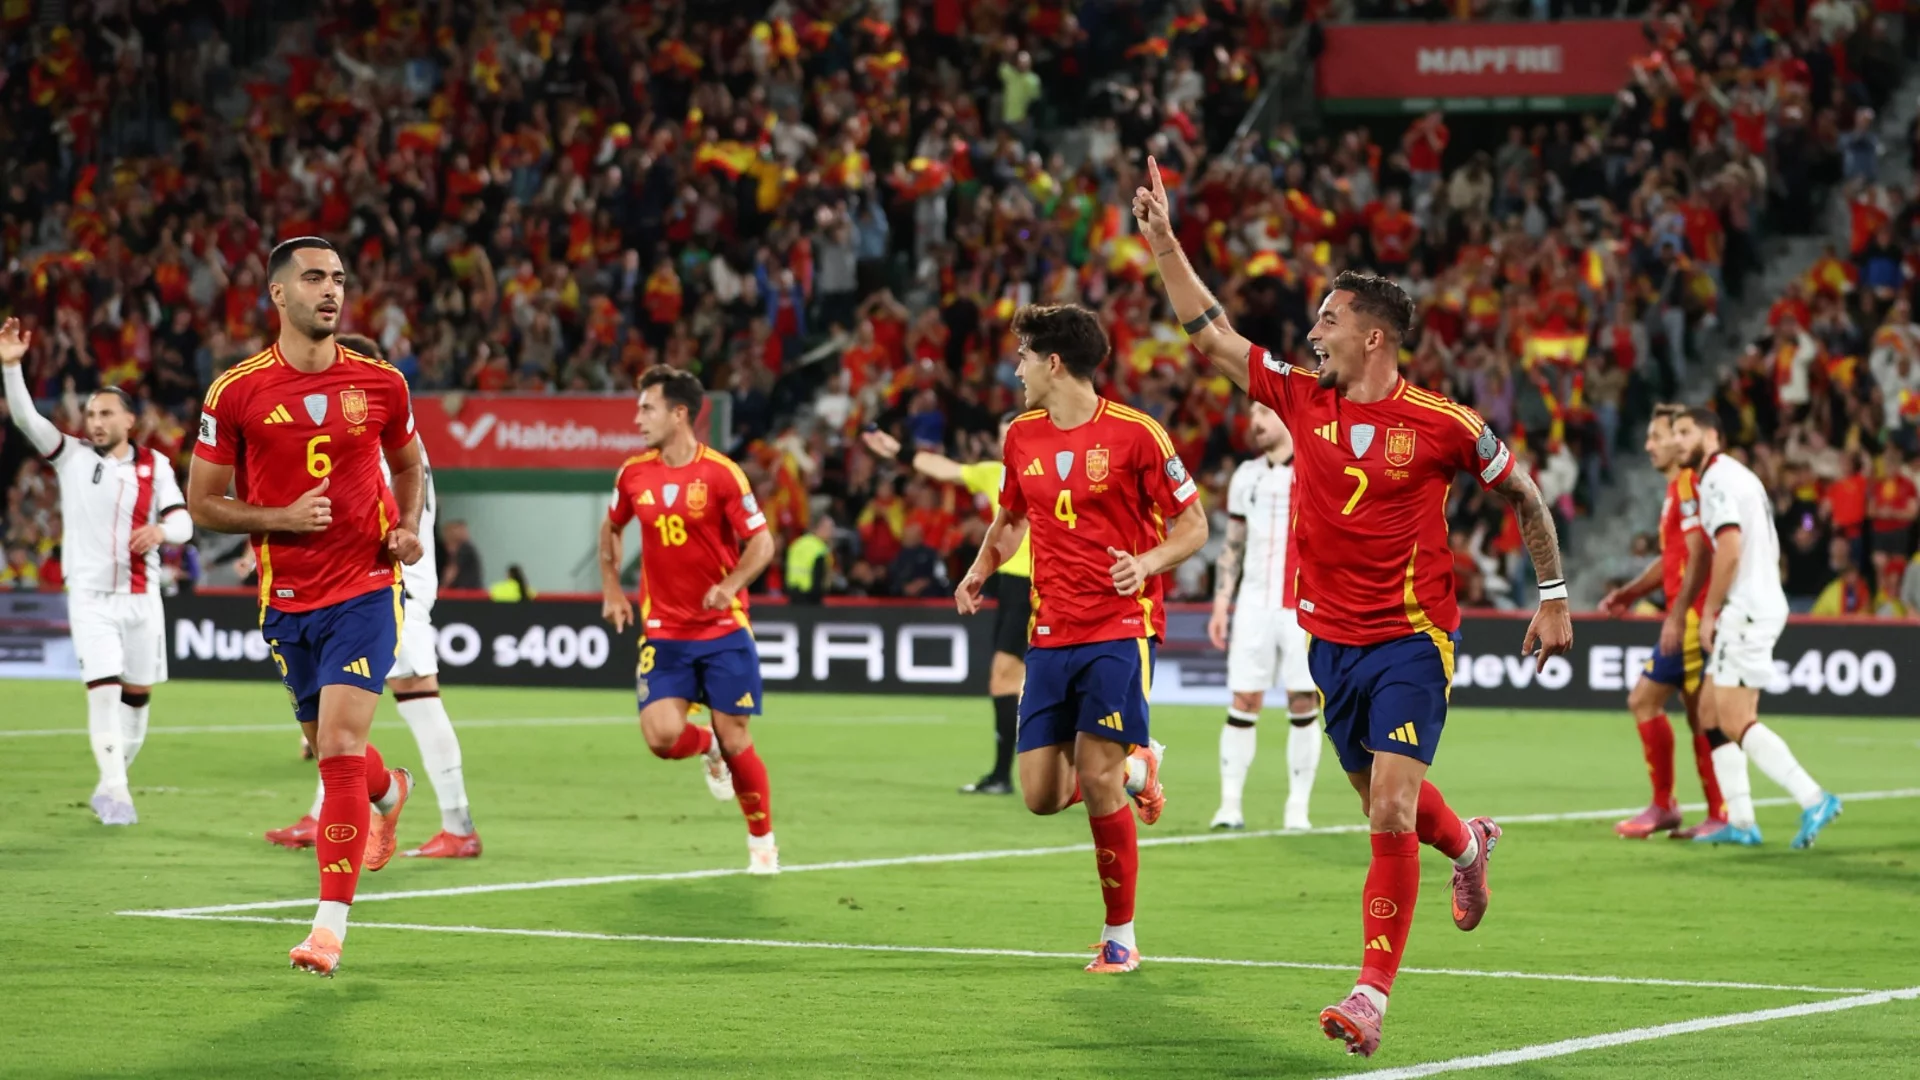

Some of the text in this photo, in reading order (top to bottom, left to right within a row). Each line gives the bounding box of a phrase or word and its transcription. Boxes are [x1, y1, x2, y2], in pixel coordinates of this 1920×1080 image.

[1418, 45, 1562, 74] MAPFRE
[496, 419, 598, 450] Halcón
[306, 435, 332, 478] 6
[1054, 489, 1078, 530] 4
[1342, 466, 1369, 516] 7
[654, 514, 688, 547] 18
[175, 618, 271, 661] Nue
[492, 624, 609, 668] s400
[1451, 653, 1572, 690] uevo
